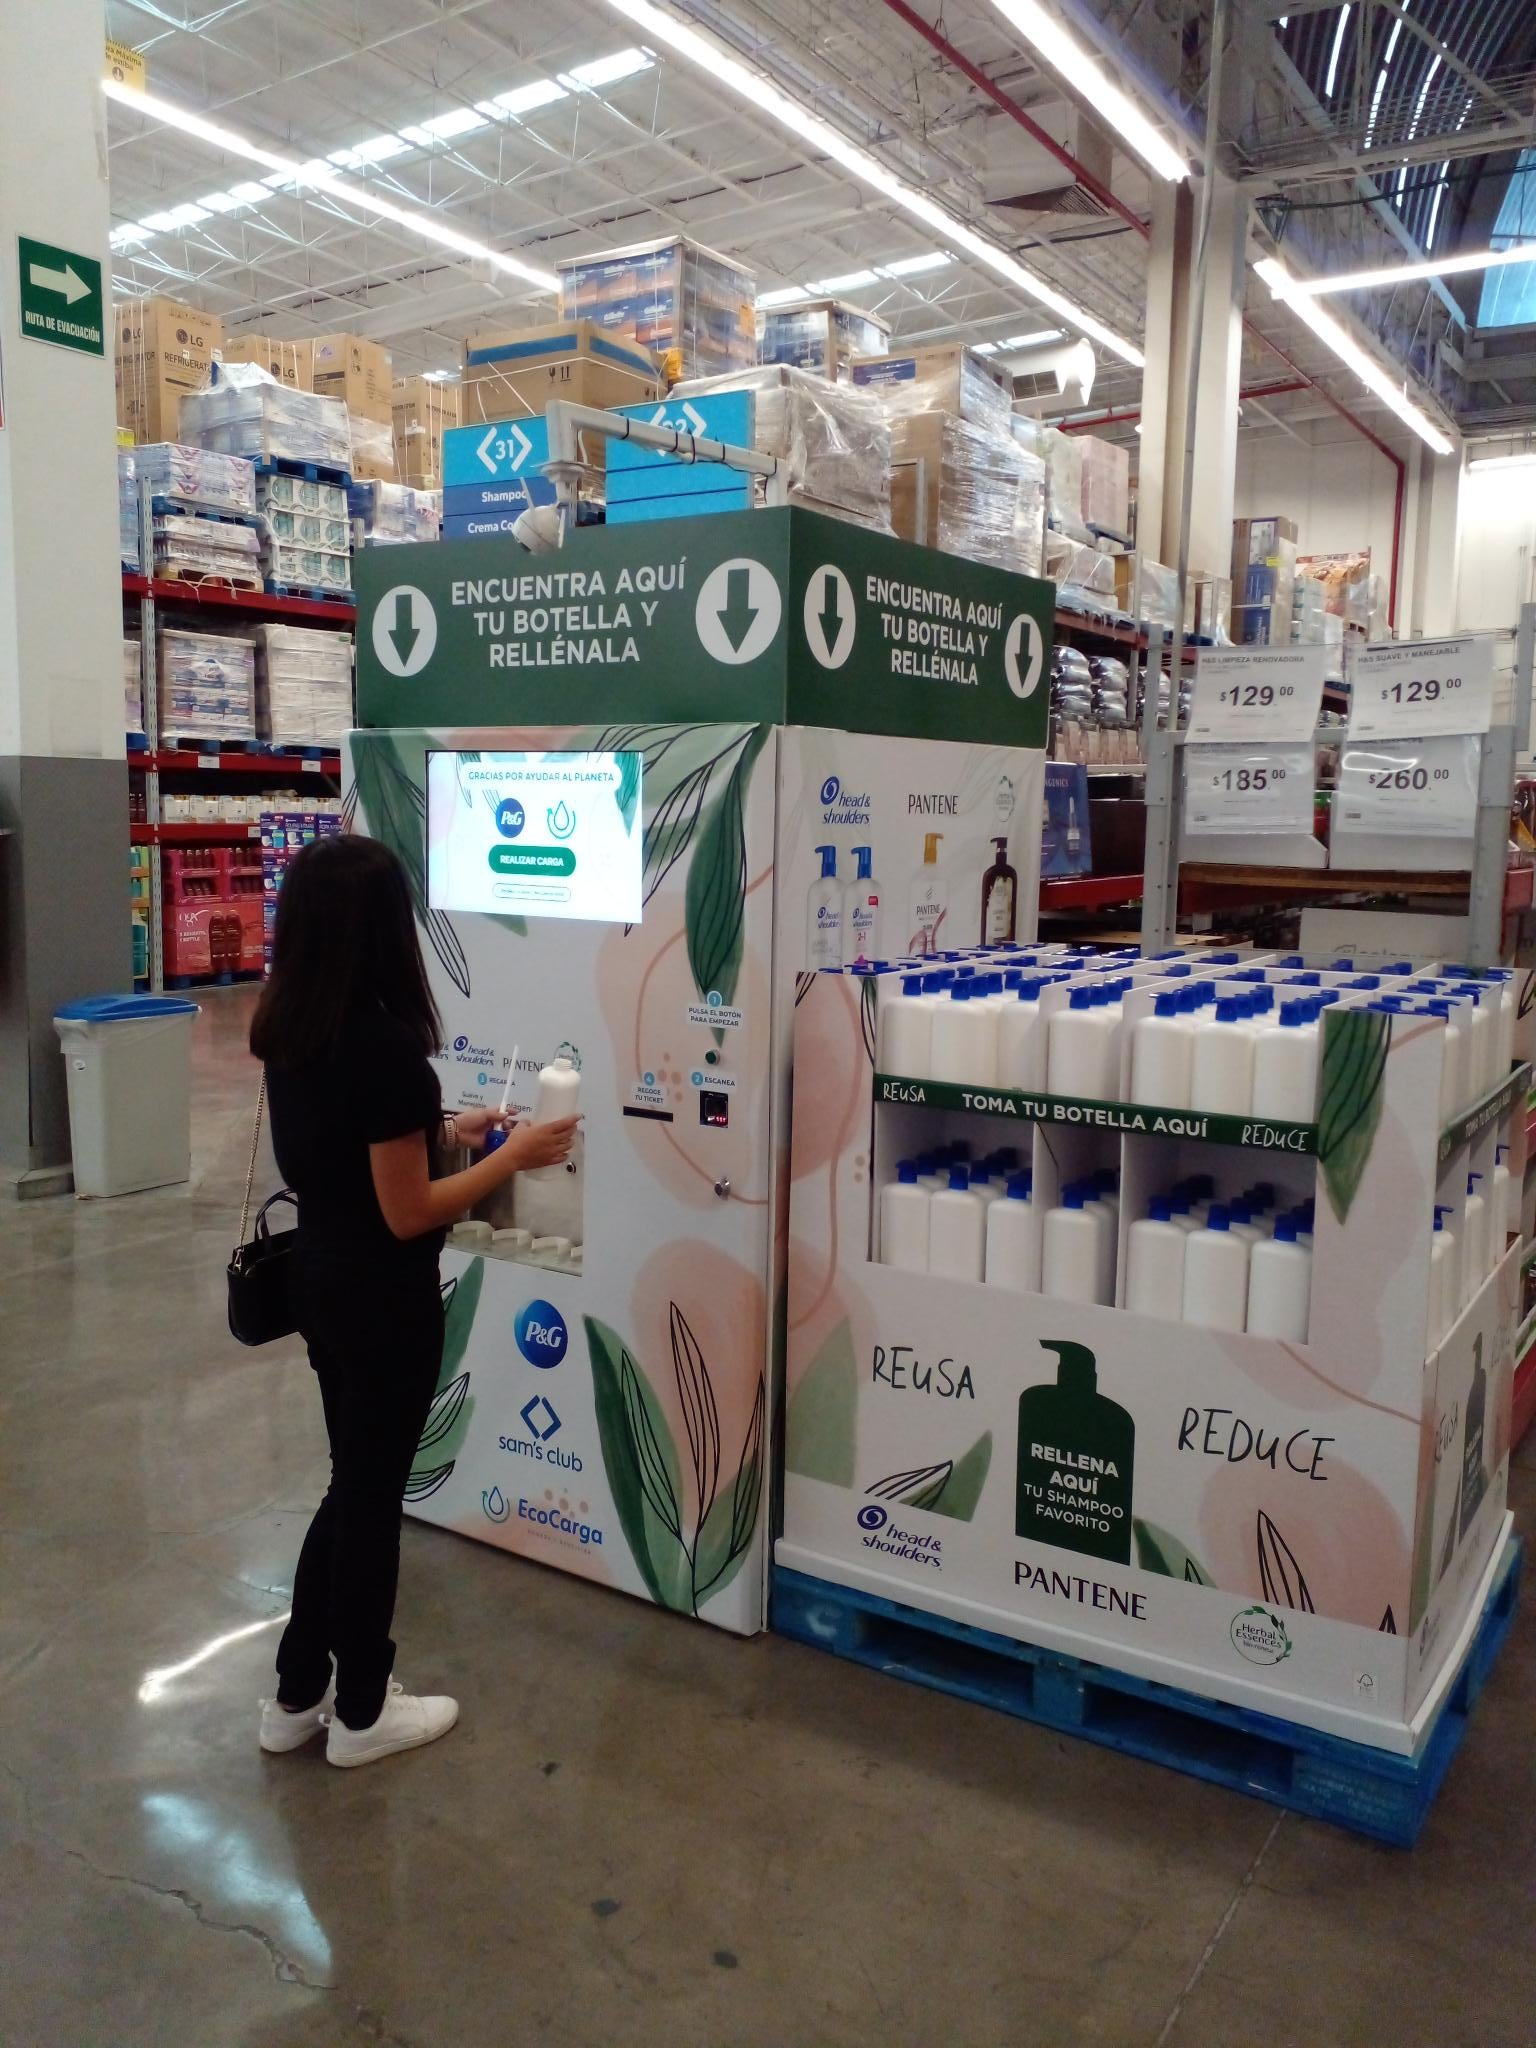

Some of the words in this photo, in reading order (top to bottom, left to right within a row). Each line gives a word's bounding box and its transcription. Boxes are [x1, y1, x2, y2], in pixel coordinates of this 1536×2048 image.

[25, 311, 45, 328] RUTA
[46, 316, 56, 331] DE
[57, 319, 100, 343] EVACUACIÓN
[190, 334, 204, 348] LG
[283, 368, 295, 379] LG
[494, 440, 516, 461] 31
[467, 521, 499, 534] Crema
[451, 570, 606, 606] ENCUENTRA
[615, 556, 687, 595] AQUÍ
[866, 574, 963, 622] ENCUENTRA
[965, 601, 1003, 630] AQUÍ
[473, 611, 505, 637] TU
[513, 602, 632, 635] BOTELLA
[640, 600, 659, 628] Y
[880, 612, 903, 641] TU
[907, 618, 975, 656] BOTELLA
[978, 633, 989, 657] Y
[489, 633, 641, 669] RELLÉNALA
[891, 648, 979, 686] RELLÉNALA
[468, 770, 504, 781] GRACIAS
[505, 771, 524, 782] POR
[525, 771, 560, 782] AYUDAR
[562, 772, 573, 782] AL
[574, 772, 614, 782] PLANETA
[822, 807, 870, 825] shoulders
[908, 794, 960, 816] PANTENE
[500, 810, 523, 827] P&G
[499, 855, 536, 867] REALIZAR
[537, 856, 564, 868] CARGA
[916, 902, 941, 916] PANTENE
[688, 1007, 709, 1016] PULSA
[710, 1009, 717, 1017] EL
[718, 1009, 742, 1019] BOTÓN
[690, 1016, 708, 1024] PARA
[708, 1018, 739, 1027] EMPEZAR
[456, 1053, 495, 1066] shoulders
[637, 1086, 661, 1096] RECOGE
[704, 1076, 736, 1087] ESCANEA
[644, 1095, 664, 1104] TICKET
[962, 1093, 1016, 1115] TOMA
[1024, 1101, 1048, 1119] TU
[1053, 1104, 1147, 1131] BOTELLA
[1152, 1117, 1207, 1138] AQUÍ
[525, 1321, 563, 1349] P&G
[498, 1435, 543, 1461] sam's
[546, 1446, 583, 1472] club
[1031, 1442, 1119, 1478] RELLENA
[1049, 1470, 1099, 1495] AQUÍ
[1024, 1483, 1043, 1499] TU
[1047, 1489, 1124, 1519] SHAMPOO
[517, 1498, 603, 1545] EcoCarga
[1035, 1504, 1110, 1533] FAVORITO
[862, 1535, 942, 1569] shoulders
[1014, 1560, 1148, 1621] PANTENE
[1235, 1628, 1282, 1649] Essences
[1242, 1623, 1276, 1640] Herbal
